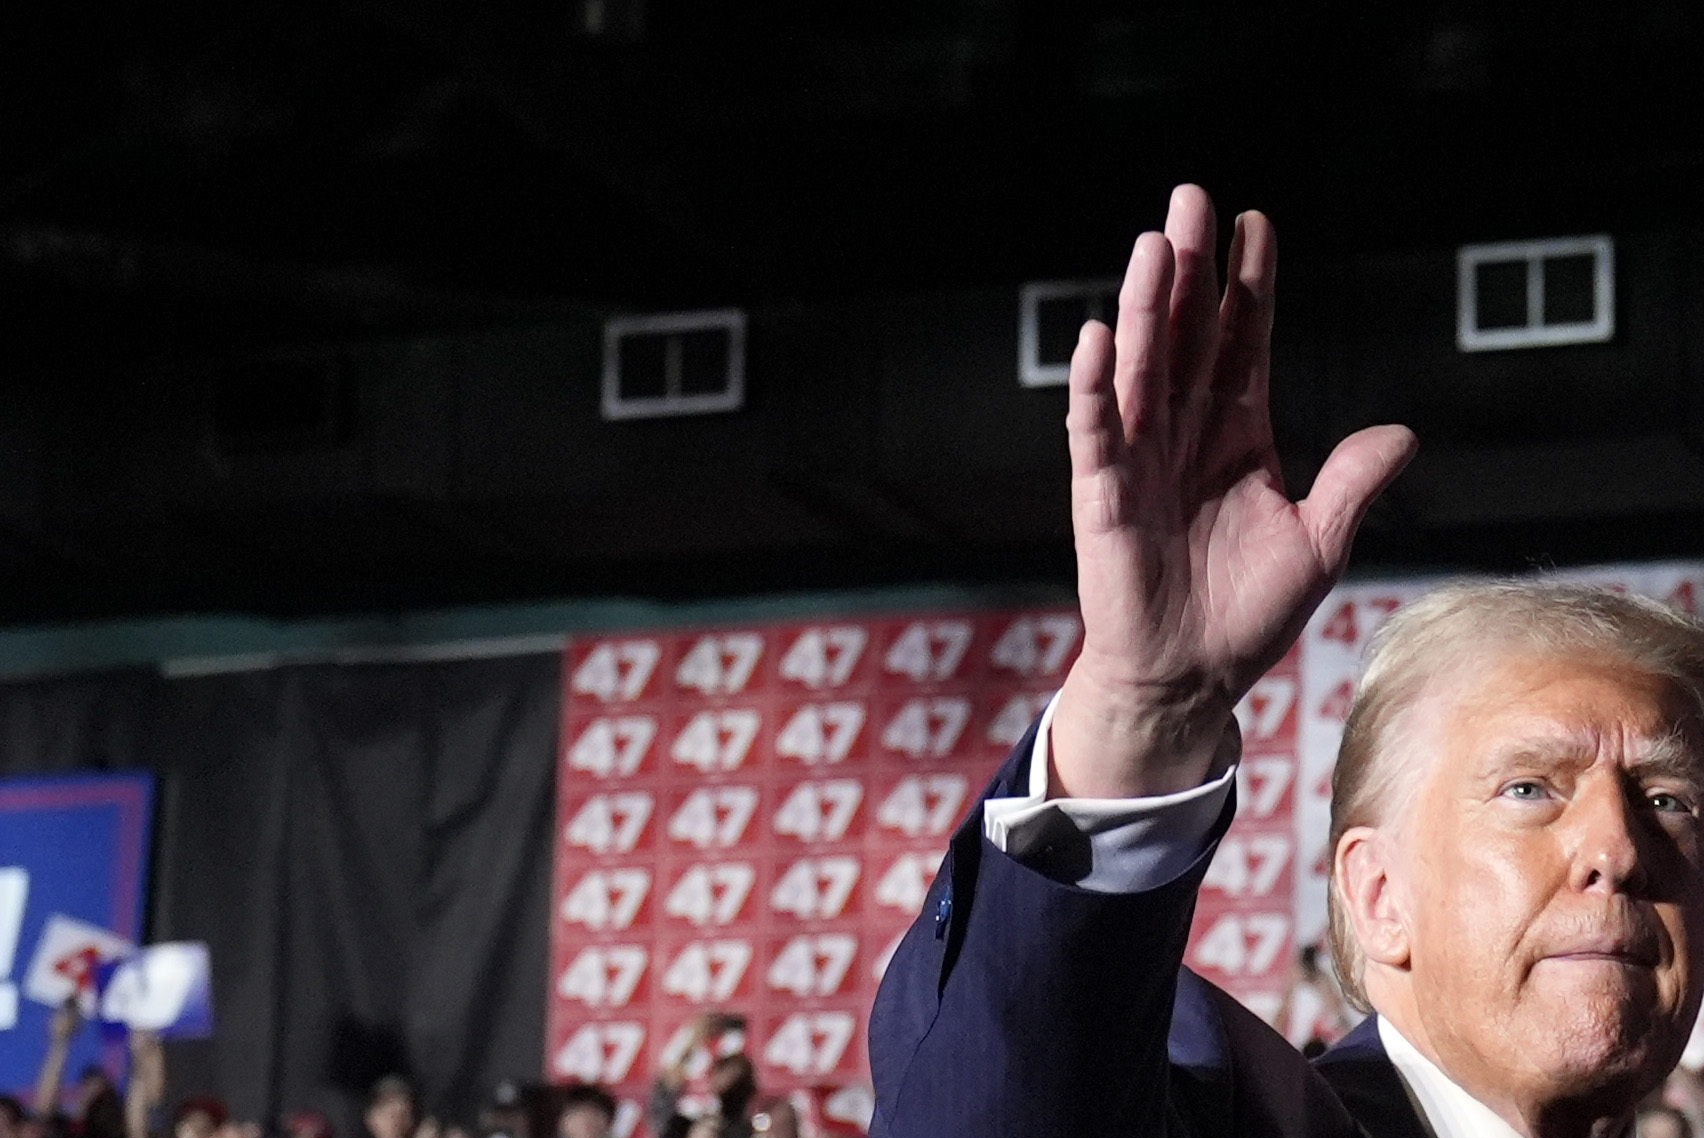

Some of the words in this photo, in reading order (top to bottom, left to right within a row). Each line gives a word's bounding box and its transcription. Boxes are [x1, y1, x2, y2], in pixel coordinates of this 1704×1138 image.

[573, 641, 660, 700] 47
[677, 634, 763, 693] 47
[780, 628, 865, 688] 47
[884, 622, 971, 682] 47
[993, 614, 1078, 676] 47
[568, 717, 655, 778] 47
[672, 710, 760, 771] 47
[775, 704, 863, 764] 47
[881, 700, 967, 757] 47
[566, 793, 652, 854] 47
[669, 787, 757, 848] 47
[774, 781, 861, 842] 47
[876, 776, 966, 835] 47
[561, 869, 649, 930] 47
[665, 864, 753, 925] 47
[771, 857, 859, 918] 47
[662, 940, 751, 1001] 47
[767, 934, 856, 996] 47
[1196, 914, 1289, 974] 47
[559, 946, 646, 1007] 47
[555, 1022, 644, 1081] 47
[764, 1013, 854, 1074] 47
